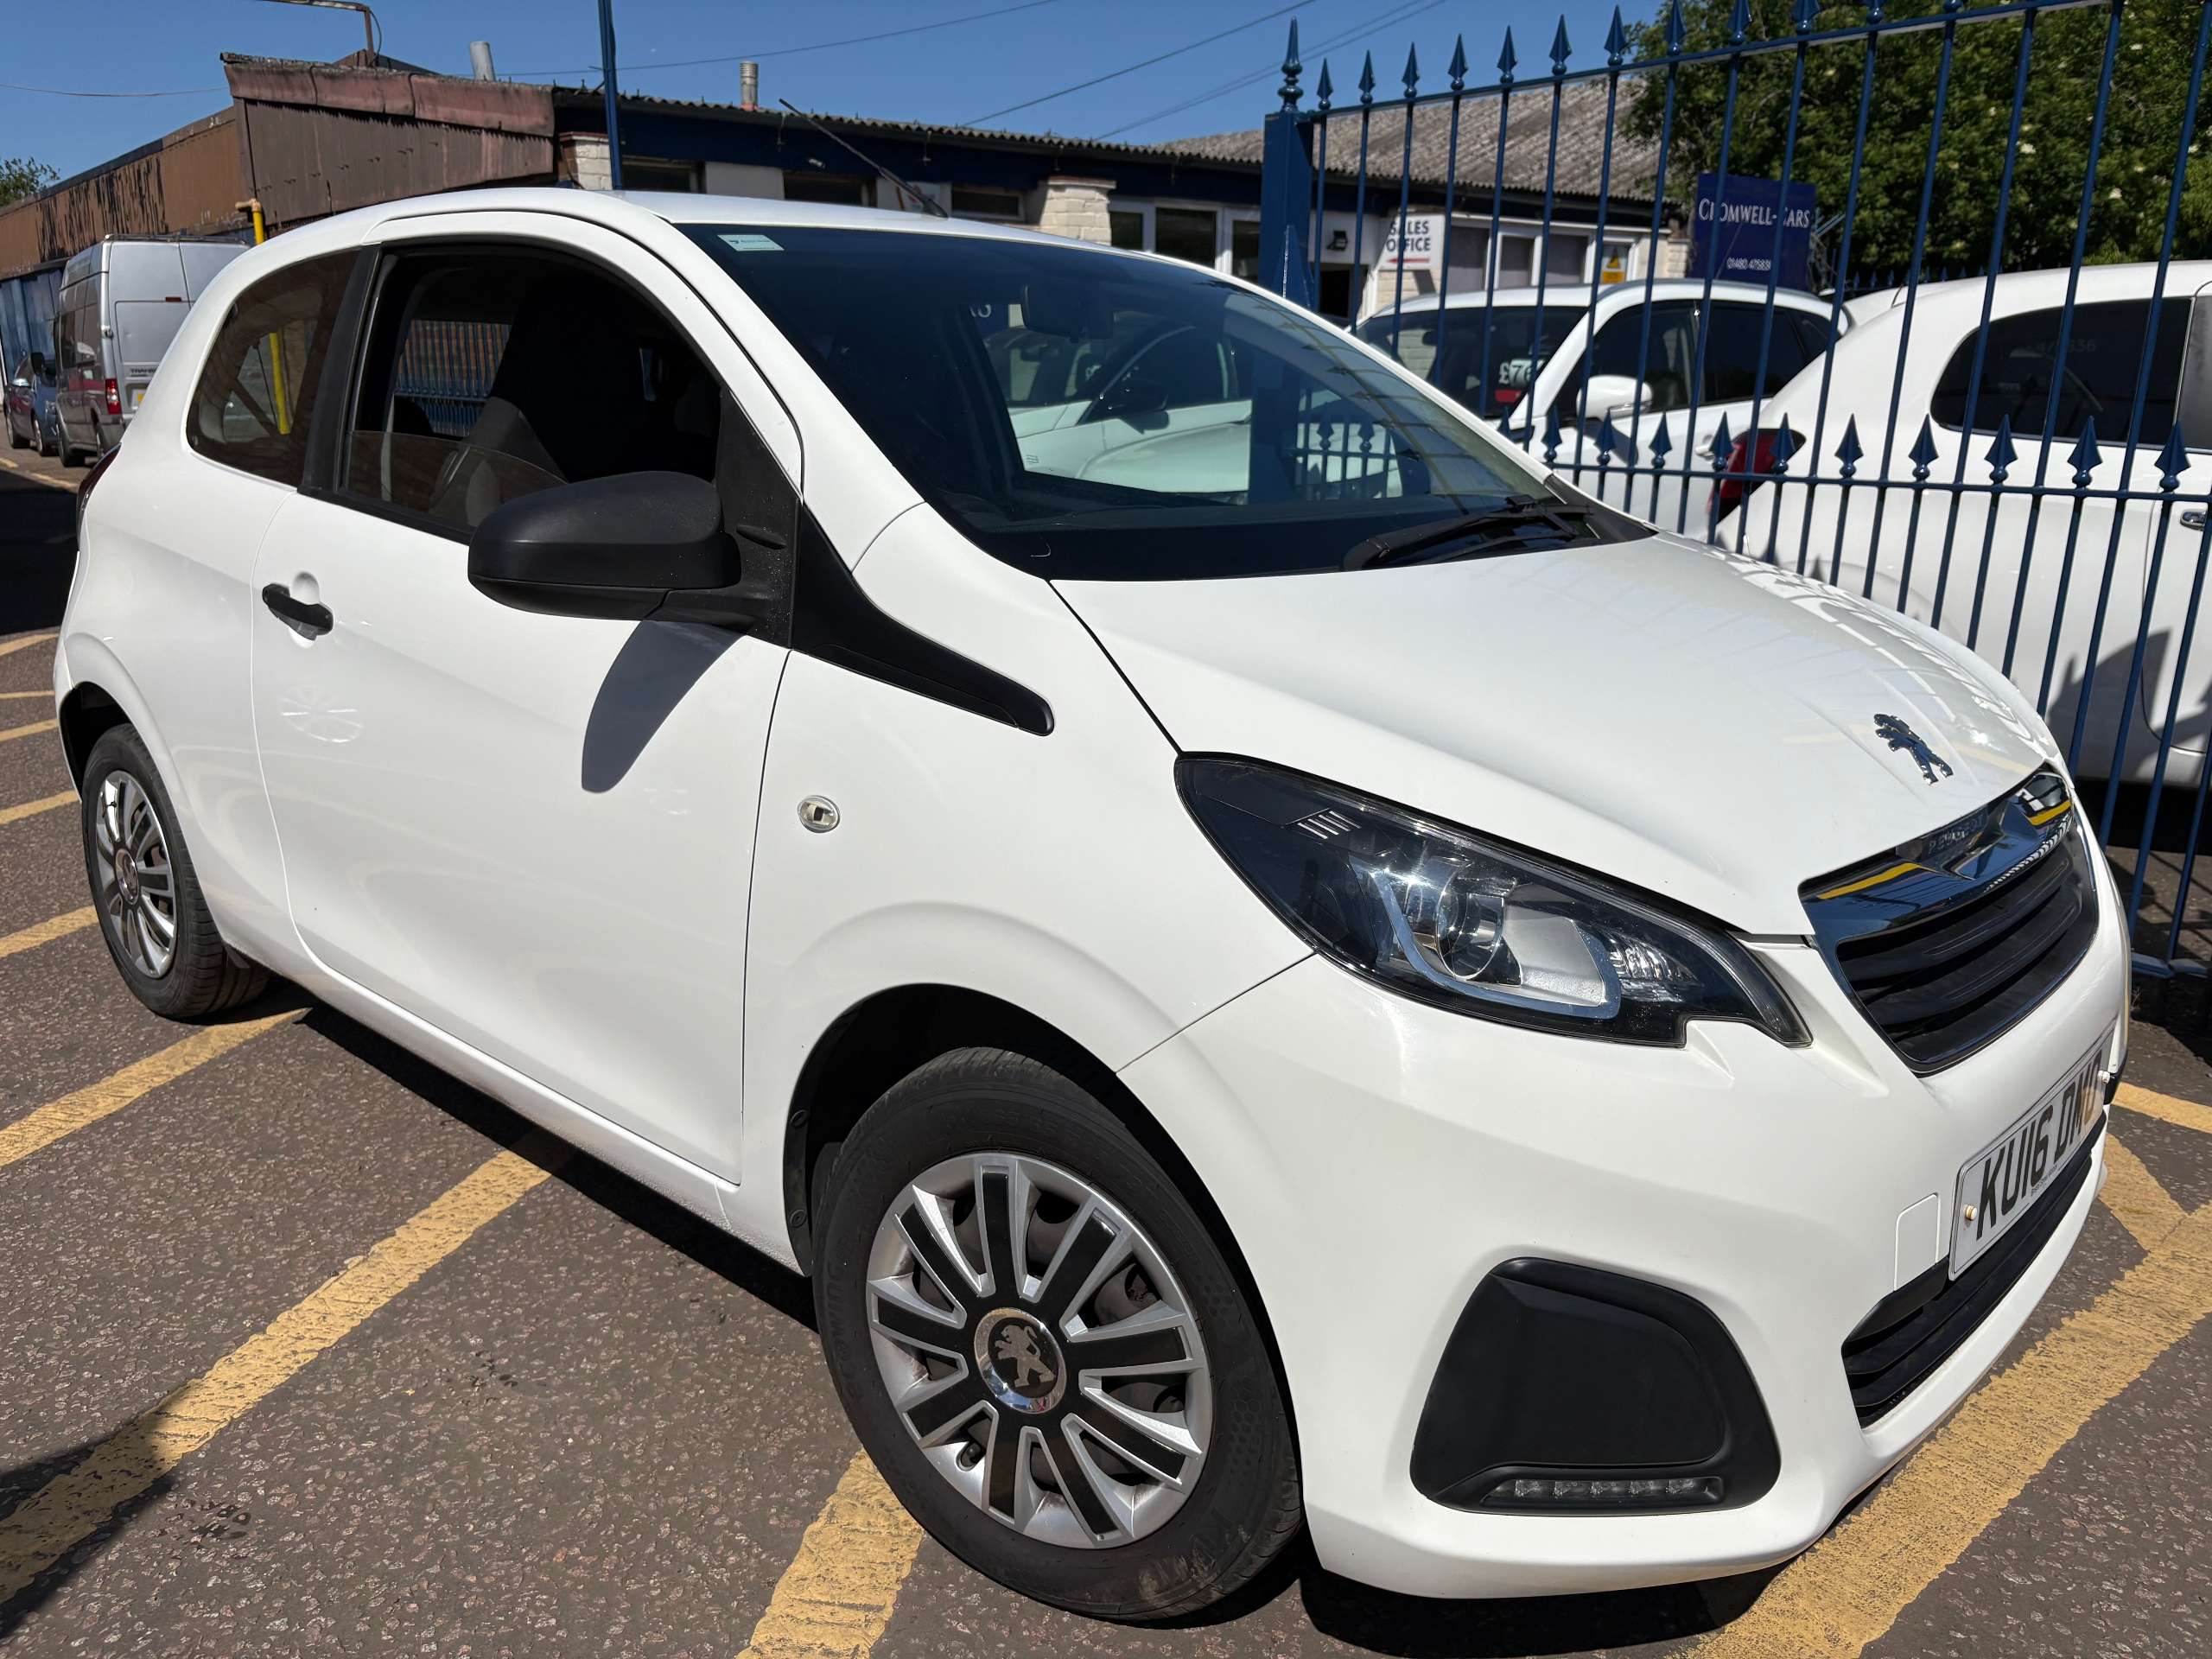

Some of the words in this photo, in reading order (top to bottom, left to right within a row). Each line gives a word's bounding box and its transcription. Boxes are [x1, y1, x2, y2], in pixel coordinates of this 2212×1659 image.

[1389, 219, 1430, 235] SLES
[1385, 237, 1432, 252] OFICE
[1976, 1103, 2054, 1242] KU16
